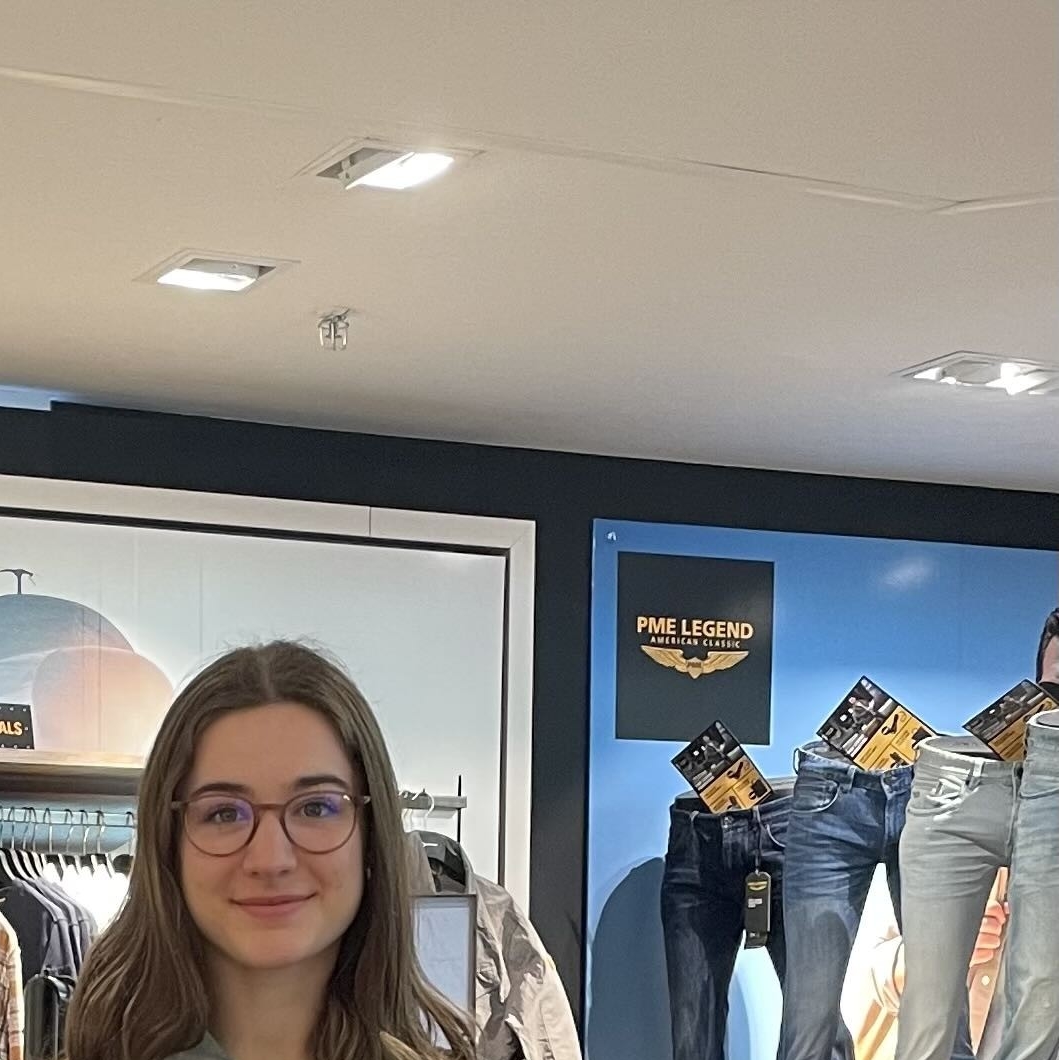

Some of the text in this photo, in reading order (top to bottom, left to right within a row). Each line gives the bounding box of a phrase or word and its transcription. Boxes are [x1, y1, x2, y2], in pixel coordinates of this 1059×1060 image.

[636, 616, 754, 639] PME LEGEND
[650, 635, 741, 649] AMERICAN CLASSIC
